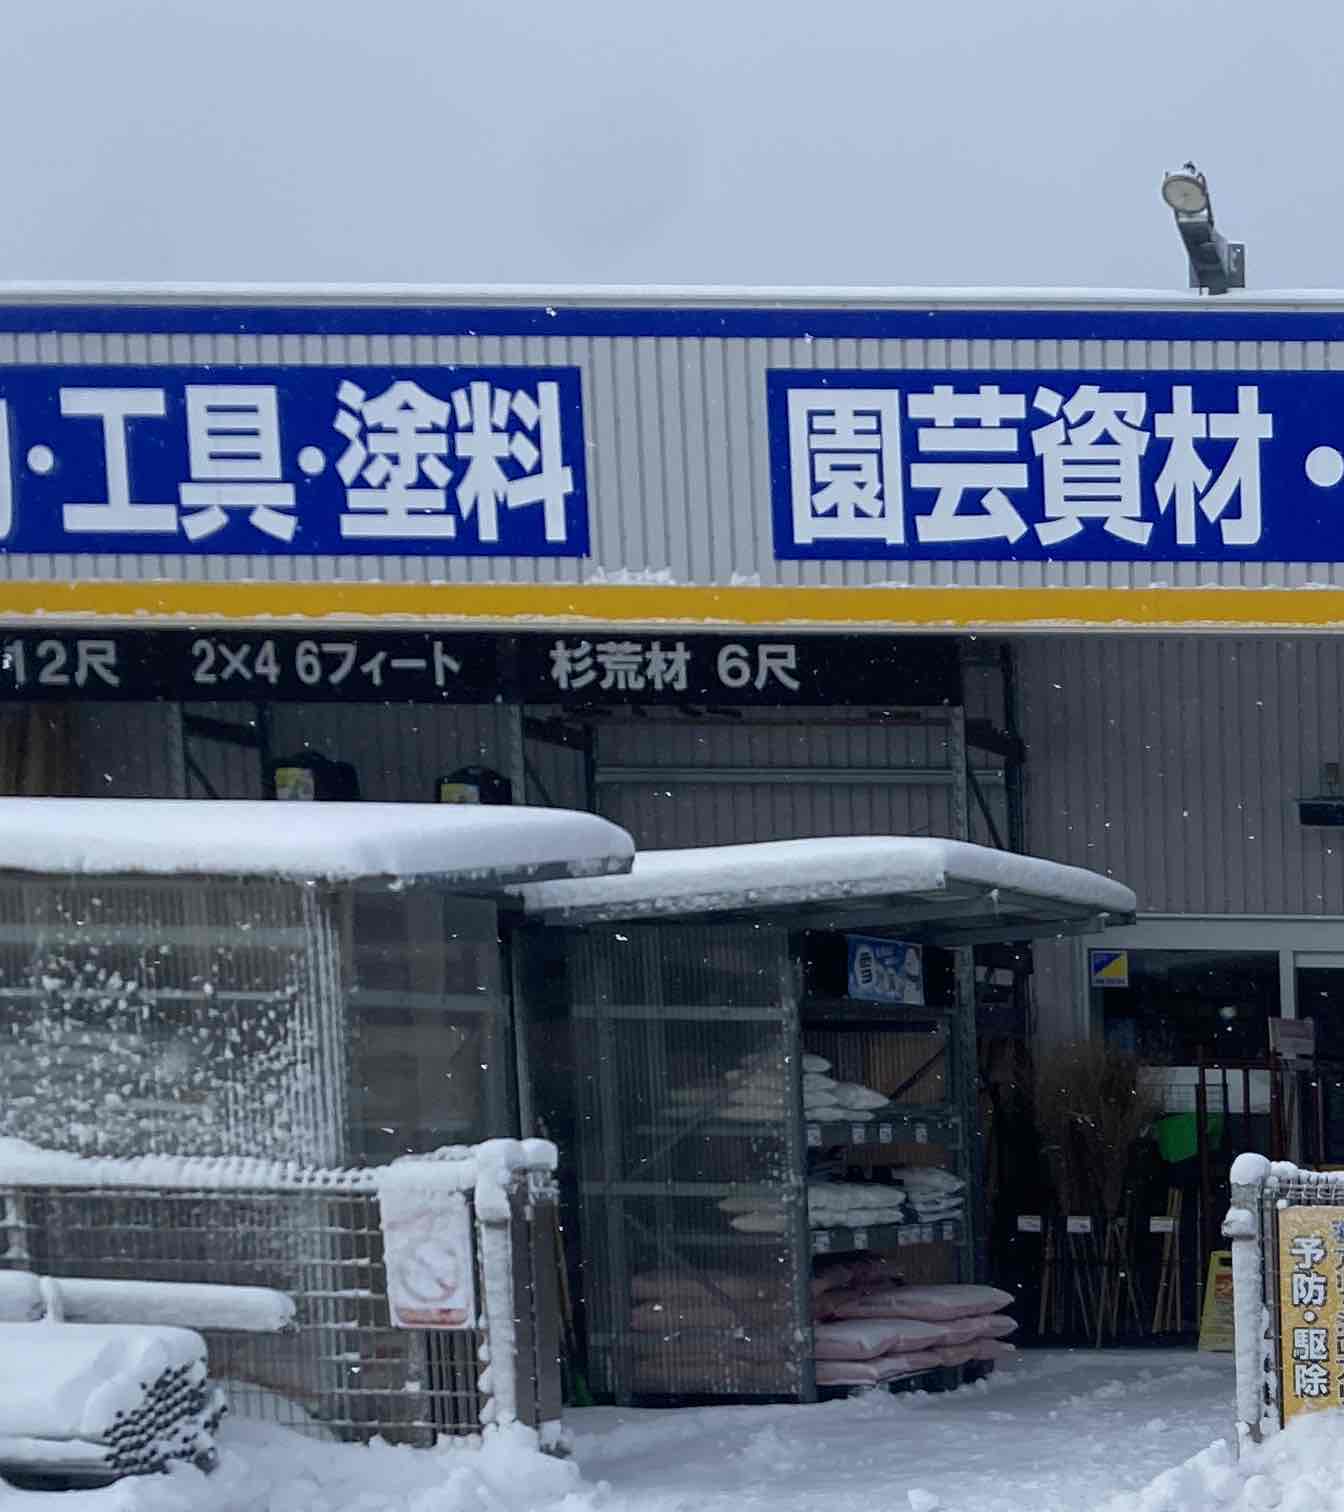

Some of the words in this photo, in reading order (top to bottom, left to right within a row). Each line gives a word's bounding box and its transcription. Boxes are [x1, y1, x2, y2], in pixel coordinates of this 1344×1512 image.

[0, 380, 575, 543] ・工具・塗料
[296, 640, 462, 688] 6フィート
[551, 640, 689, 691] 杉荒材
[718, 643, 801, 691] 6尺
[1289, 1234, 1330, 1399] 予防・駆除
